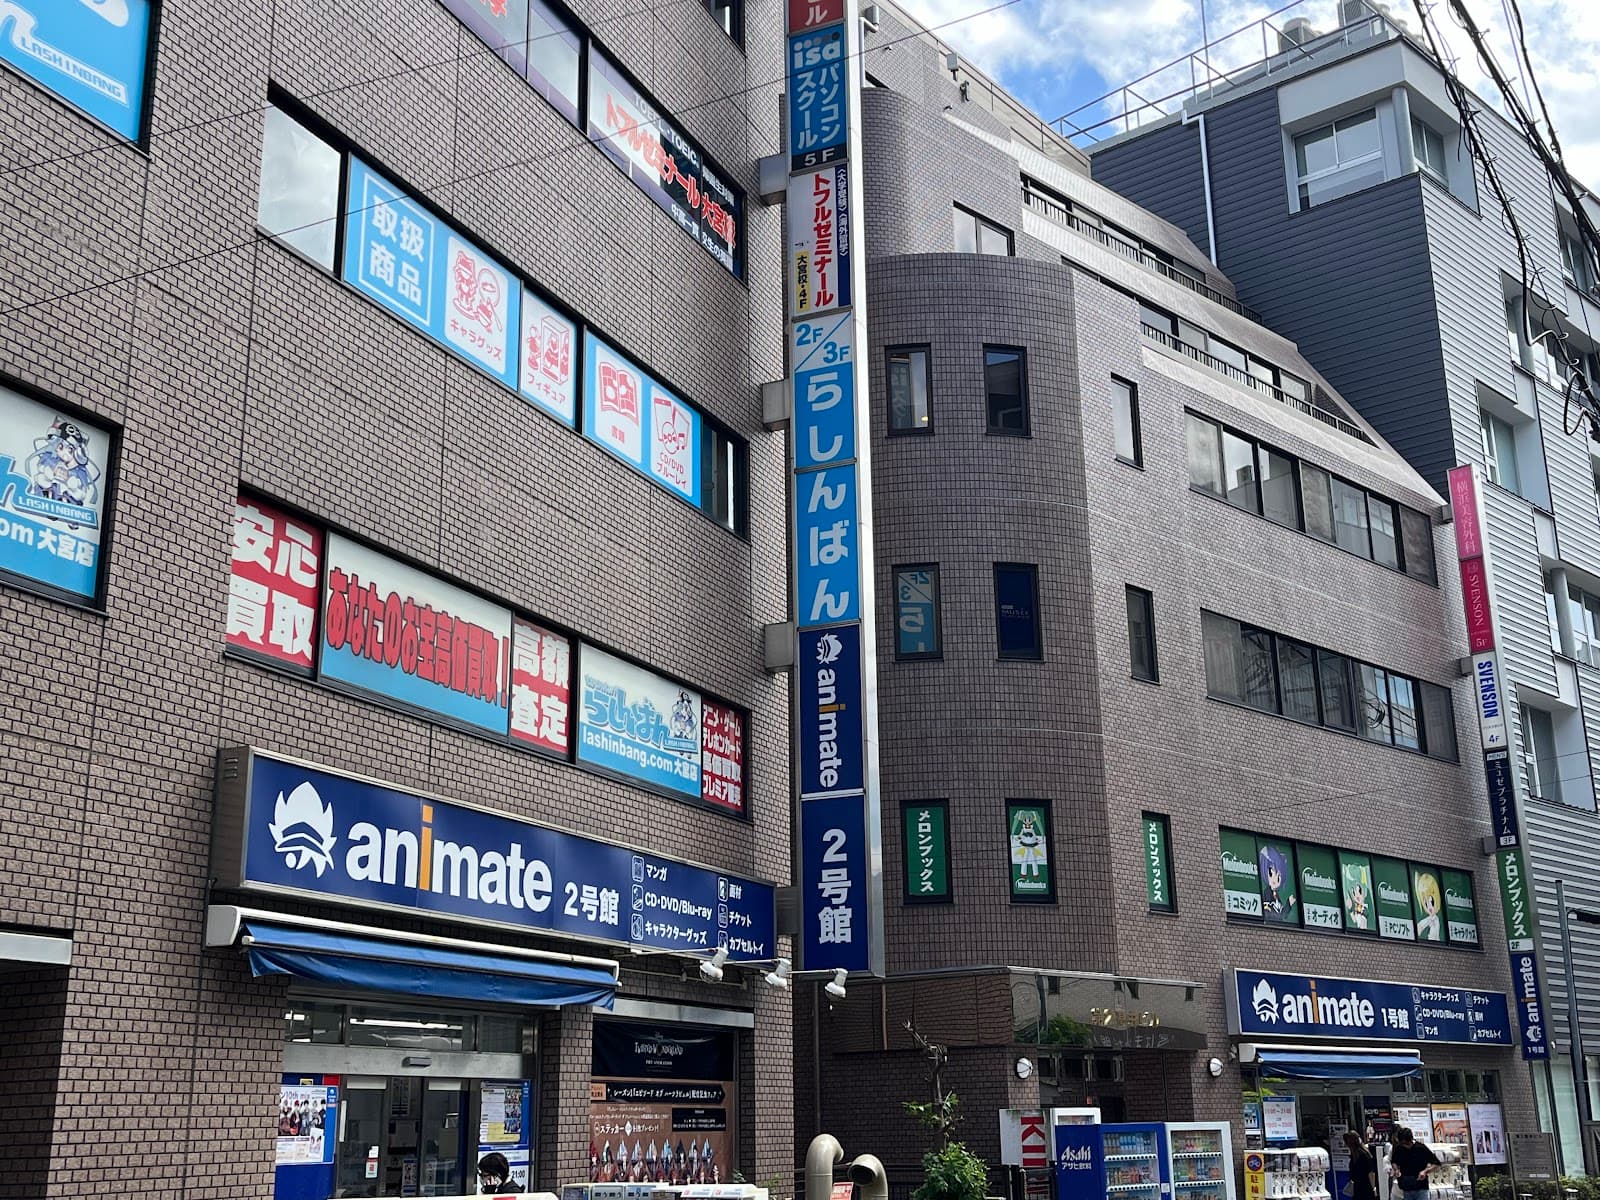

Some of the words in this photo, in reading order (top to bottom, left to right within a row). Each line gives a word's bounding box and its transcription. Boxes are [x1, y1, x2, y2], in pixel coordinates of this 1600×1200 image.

[19, 37, 122, 99] LASHINBANG
[794, 41, 841, 67] isa
[797, 73, 817, 150] スクール
[819, 65, 841, 143] パソコン
[803, 147, 836, 167] 5F
[372, 193, 426, 263] 取扱
[813, 173, 835, 308] トフルゼミナール
[369, 239, 423, 306] 商品
[450, 317, 502, 361] キャラグッズ
[796, 322, 824, 346] 2F
[823, 341, 850, 364] 3F
[527, 372, 567, 404] フィギュア
[656, 461, 687, 490] ブルーレイ
[659, 451, 684, 475] CD/DVD
[19, 497, 92, 522] LASHINBANG
[807, 370, 850, 622] らしんばん
[37, 530, 95, 568] 大宮店
[233, 503, 318, 590] 安心
[225, 573, 317, 662] 買取
[1469, 574, 1484, 626] SVENSON
[512, 622, 570, 690] 高額
[1475, 637, 1488, 648] 5F
[1477, 659, 1499, 719] SVENSON
[510, 683, 569, 748] 査定
[702, 702, 741, 738] アニメ・ゲーム
[817, 667, 847, 788] animate
[582, 725, 673, 768] lashinbang.com
[674, 760, 698, 782] 大宮店
[702, 726, 742, 760] テレホンカード
[1488, 732, 1501, 744] 4F
[1495, 761, 1511, 835] ミュゼプラチナム
[346, 803, 552, 914] animate
[564, 881, 620, 927] 2号館
[917, 809, 935, 893] メロンブックス
[1149, 821, 1163, 902] メロンブックス
[645, 863, 668, 882] マンガ
[817, 827, 852, 944] 2号館
[1232, 896, 1258, 913] コミック
[1504, 852, 1527, 937] メロンブックス
[644, 920, 708, 945] キャラクターグッズ
[728, 910, 752, 928] チケット
[1312, 909, 1339, 926] オーディオ
[1389, 922, 1411, 937] PCソフト
[728, 936, 764, 956] カプセルトイ
[1282, 979, 1375, 1028] animate
[1381, 1006, 1411, 1031] 1号館
[1420, 991, 1460, 1003] キャラクターグッズ
[1520, 956, 1541, 1023] animate
[511, 1169, 526, 1179] 21:00
[1061, 1145, 1092, 1162] Asahi
[1061, 1161, 1093, 1171] アサヒ飲料
